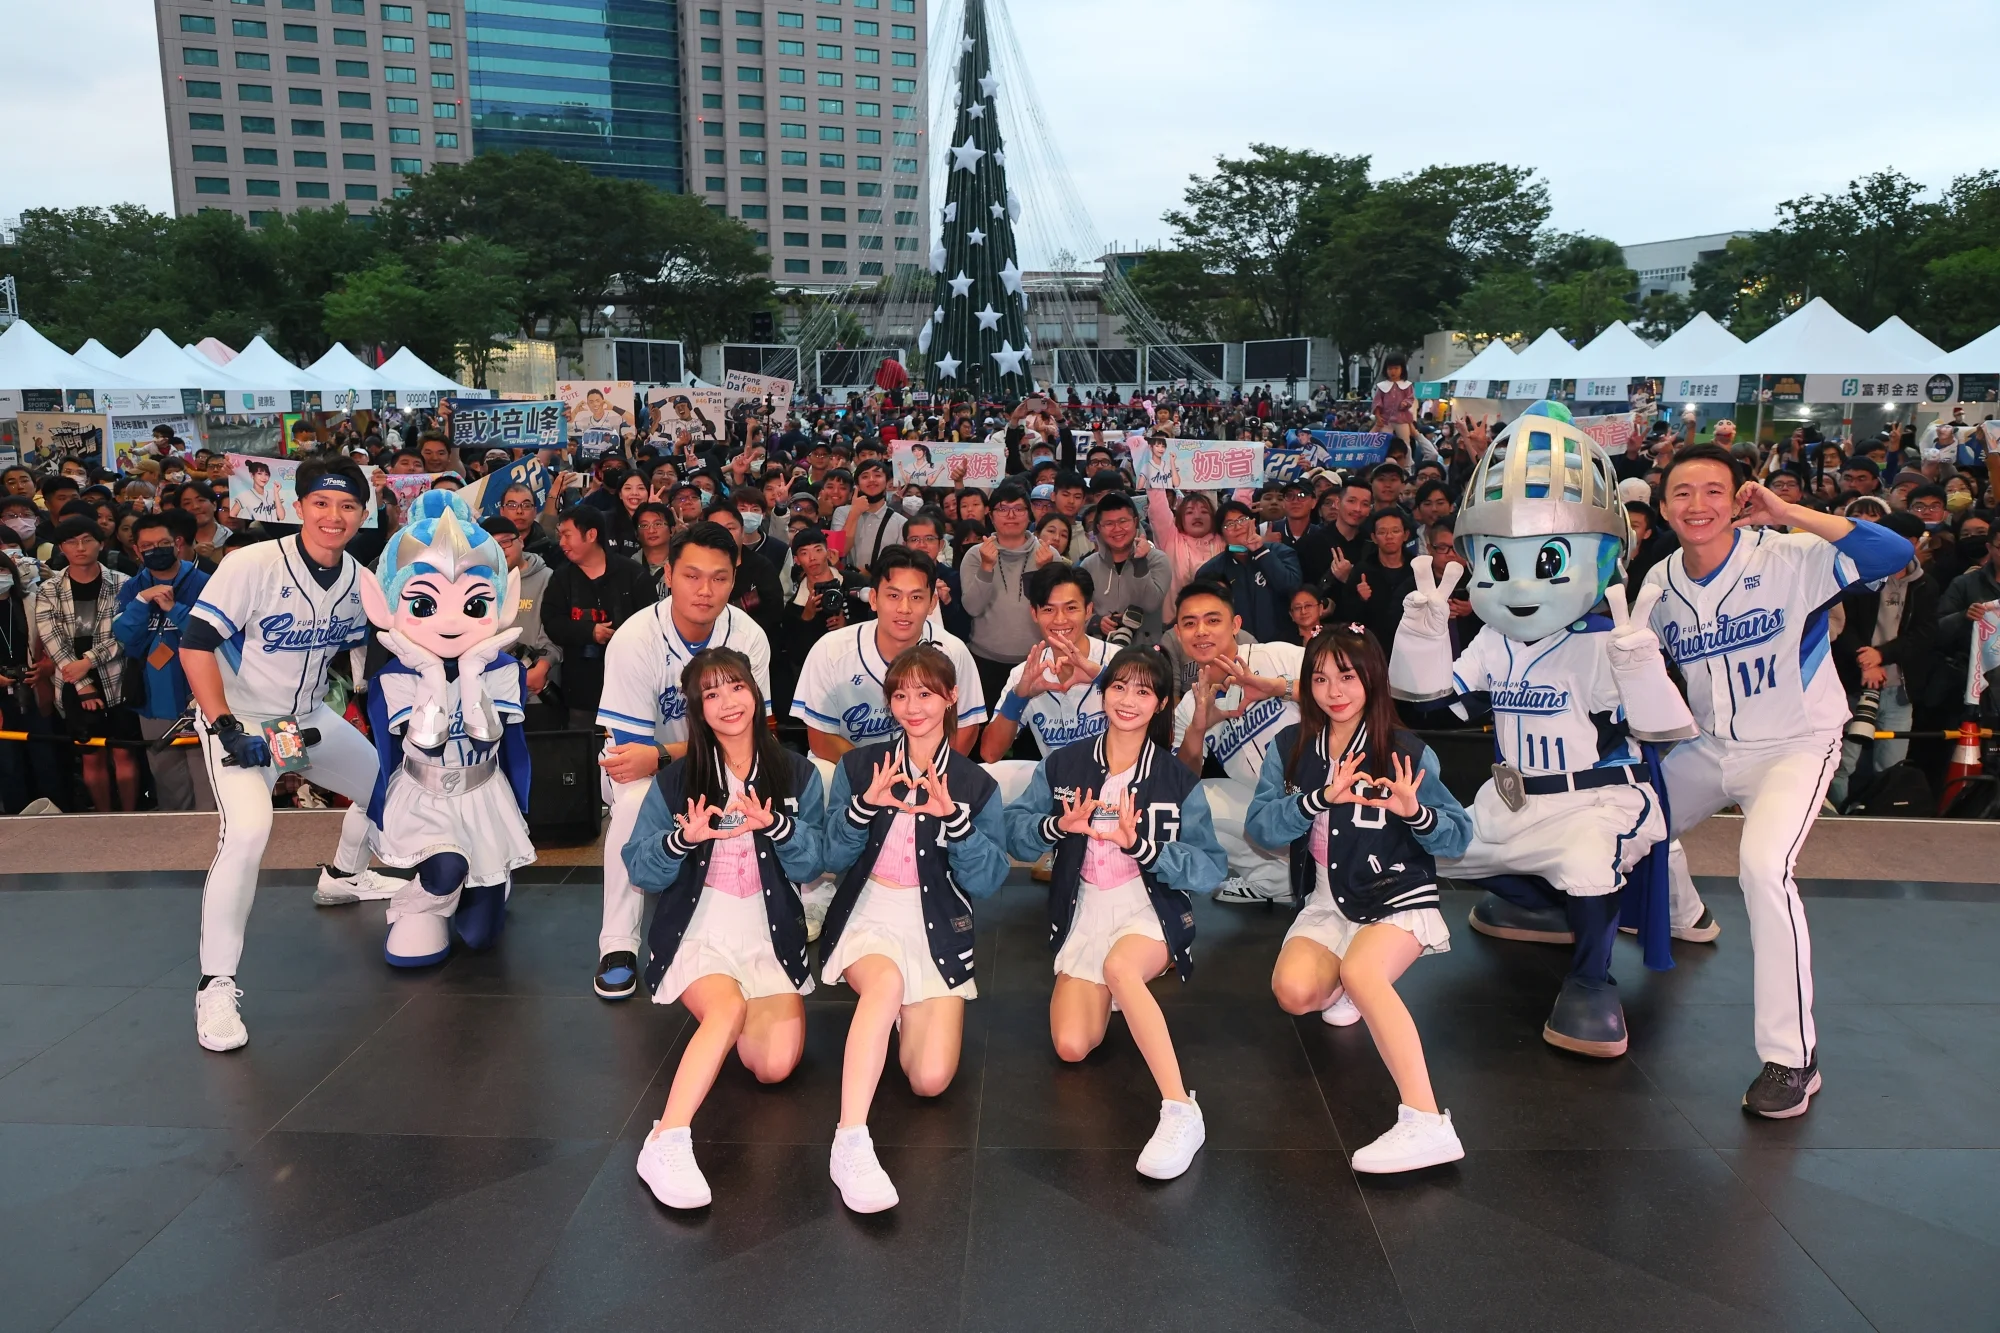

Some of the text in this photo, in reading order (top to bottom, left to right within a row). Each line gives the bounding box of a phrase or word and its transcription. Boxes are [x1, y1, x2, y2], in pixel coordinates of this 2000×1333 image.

[728, 373, 761, 385] Pei-Fong
[561, 391, 580, 402] CUTE
[745, 386, 763, 395] #95
[1862, 383, 1918, 396] 富邦金控
[406, 393, 428, 406] gogoro
[454, 405, 560, 446] 戴培峰
[538, 428, 560, 446] 95
[1325, 431, 1387, 448] Travis
[1192, 448, 1254, 482] 奶音
[1335, 453, 1364, 462] 崔維斯
[1265, 453, 1300, 481] 22
[297, 618, 327, 626] FUBON
[1682, 621, 1713, 634] FUBON
[1664, 607, 1786, 666] Guardians
[1737, 654, 1777, 698] 111
[1205, 696, 1287, 764] Guardians
[1526, 733, 1566, 771] 111
[1147, 802, 1180, 847] G
